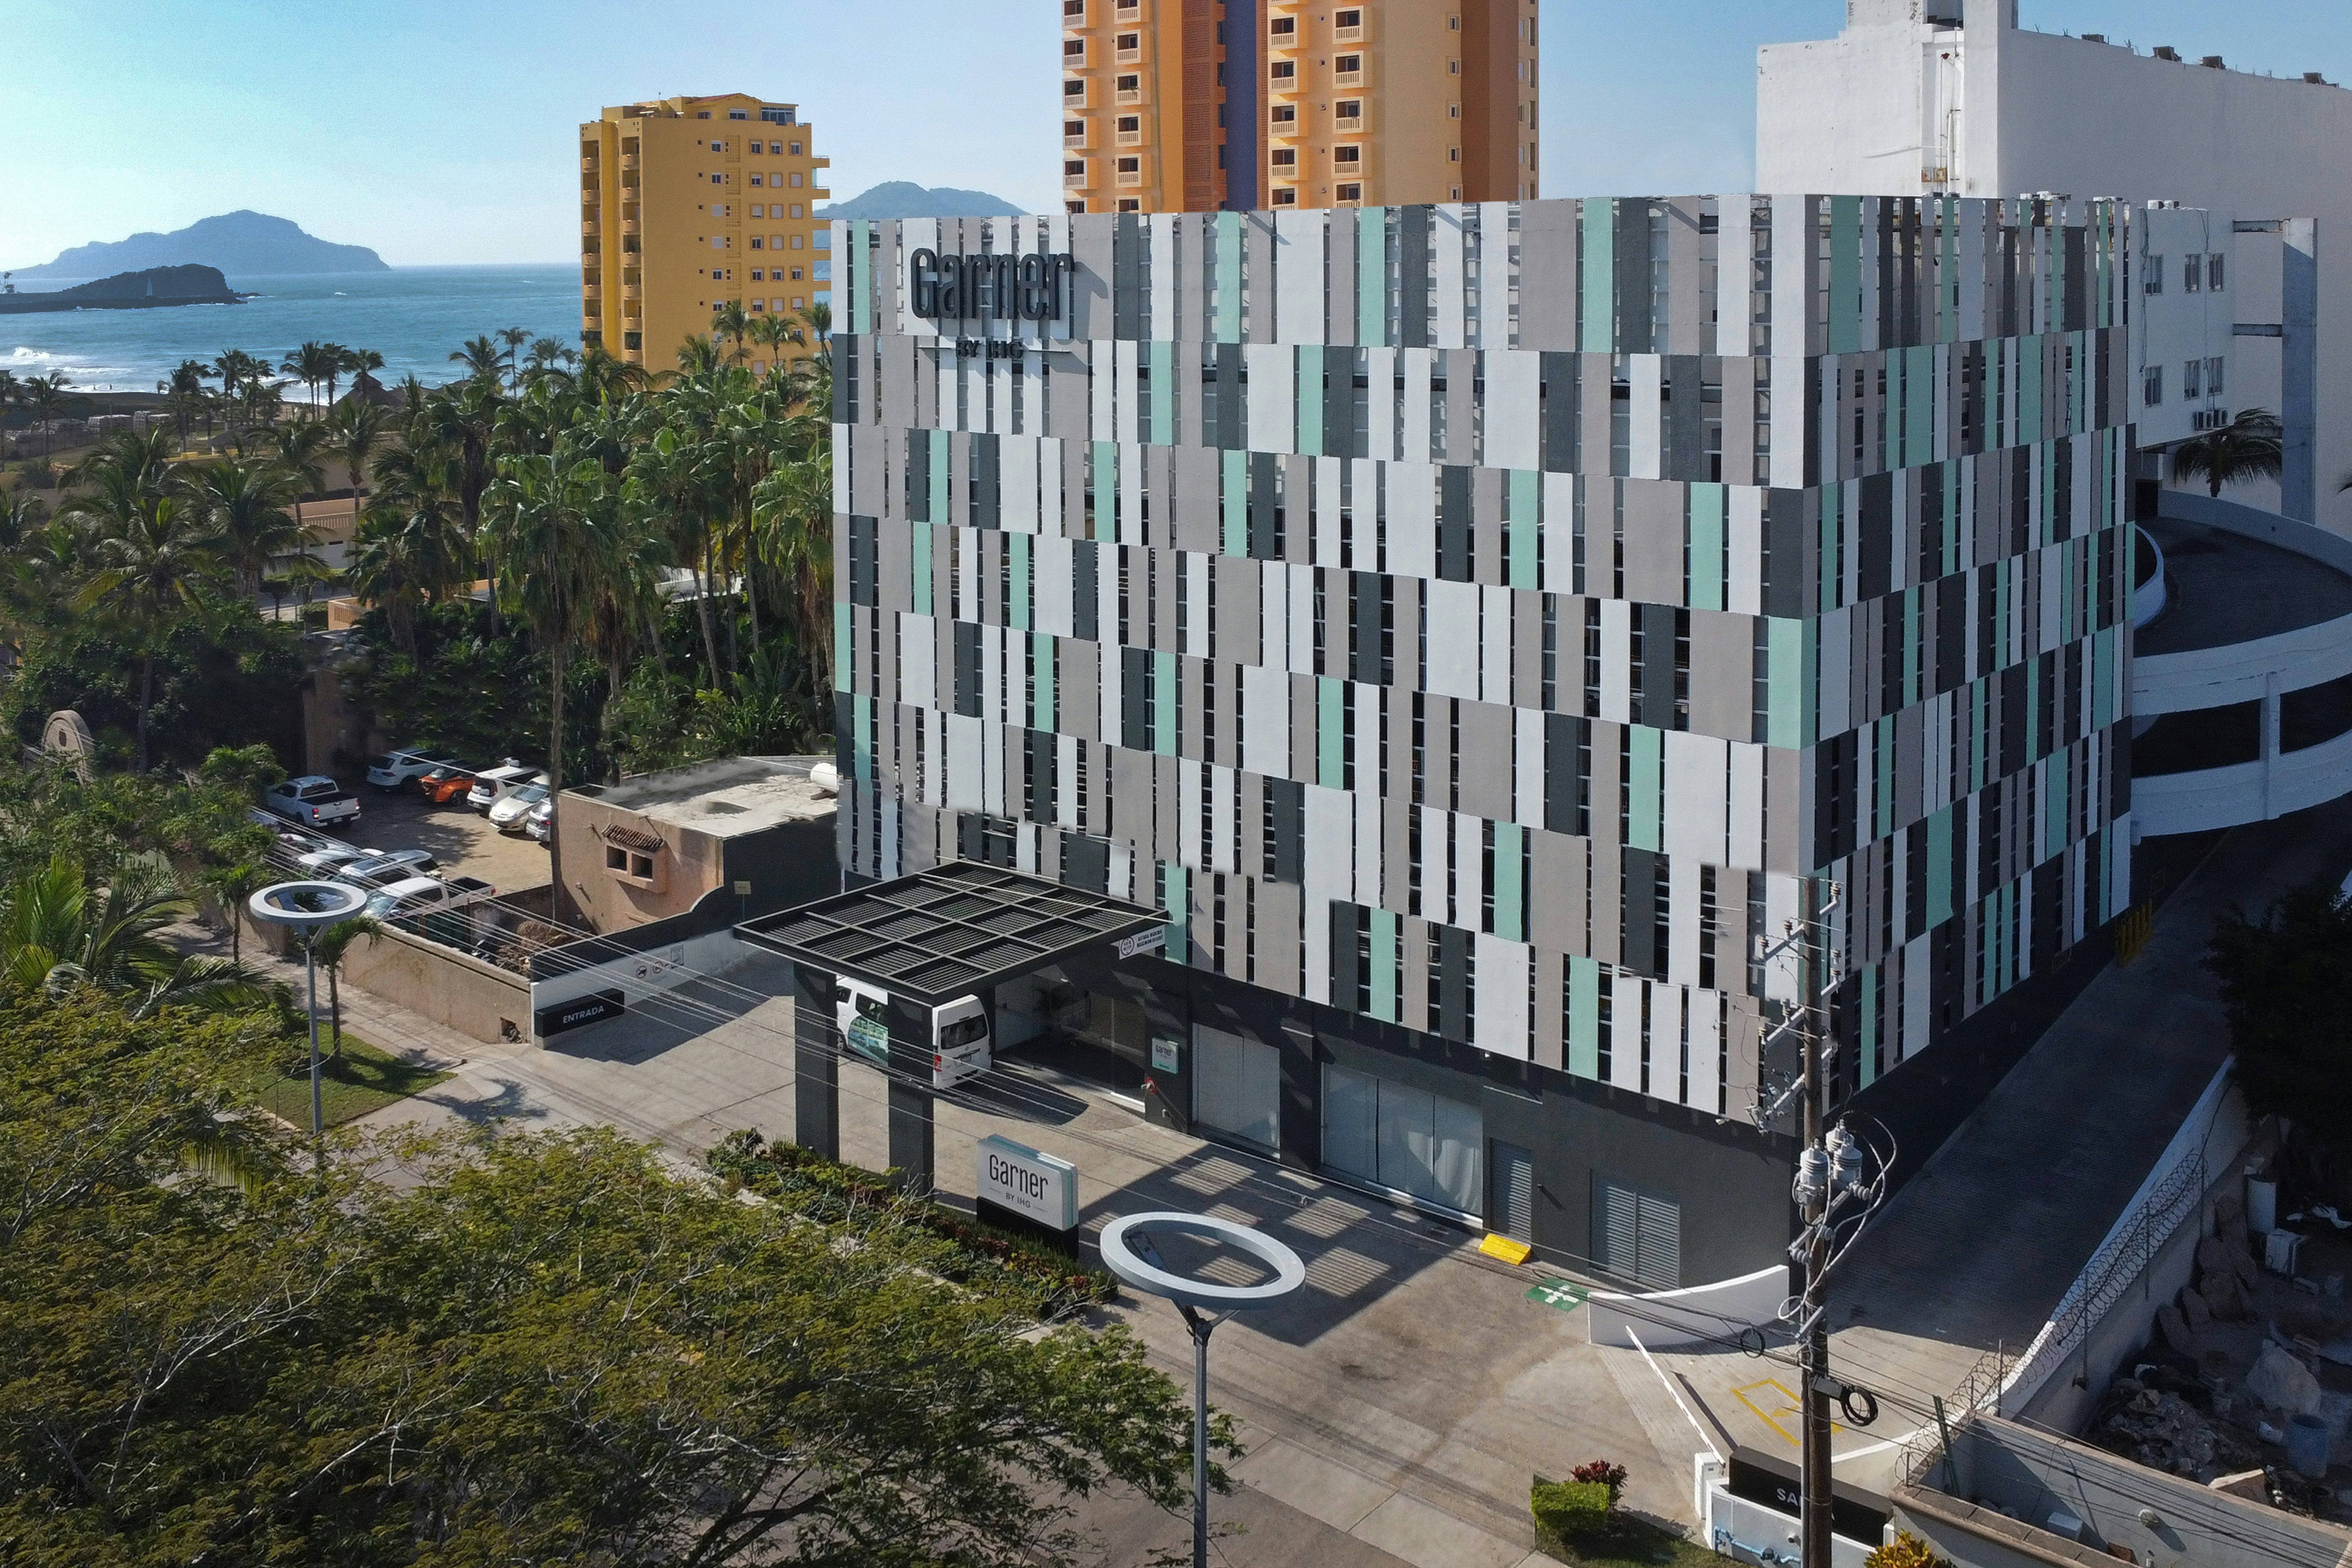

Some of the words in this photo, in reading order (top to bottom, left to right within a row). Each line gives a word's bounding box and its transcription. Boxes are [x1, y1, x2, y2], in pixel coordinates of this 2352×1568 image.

[911, 248, 1075, 321] Garner
[956, 339, 980, 358] BY
[986, 340, 1024, 359] IHG
[563, 1005, 604, 1024] ENTRADA
[989, 1154, 1048, 1200] Garner
[1006, 1192, 1014, 1201] BY
[1017, 1197, 1031, 1208] IHG
